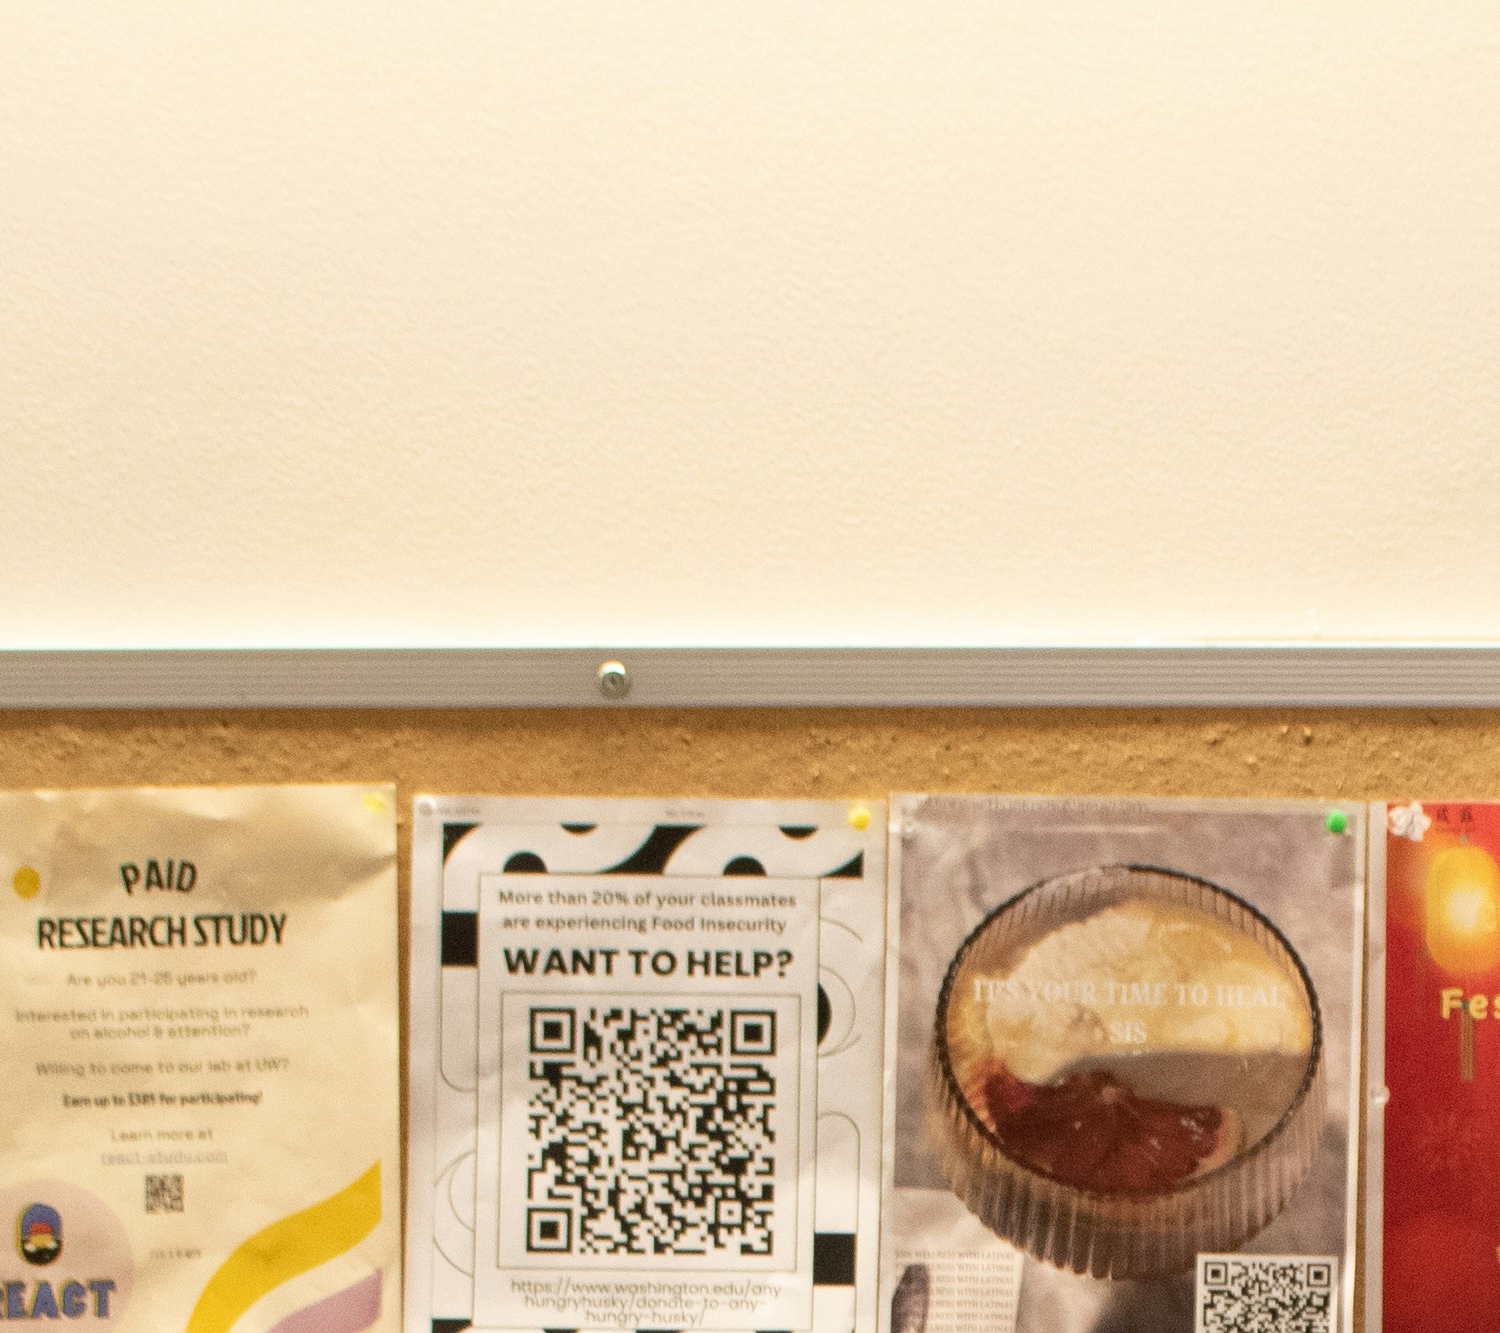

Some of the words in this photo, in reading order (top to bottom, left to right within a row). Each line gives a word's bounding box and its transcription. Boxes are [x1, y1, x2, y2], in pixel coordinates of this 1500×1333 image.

[120, 861, 198, 897] PAID
[498, 888, 539, 907] More
[545, 890, 585, 907] than
[591, 890, 629, 907] 20%
[635, 889, 650, 906] of
[654, 893, 690, 912] your
[696, 891, 796, 908] classmates
[37, 917, 188, 950] RESEARCH
[192, 914, 288, 947] STUDY
[503, 948, 618, 977] WANT
[626, 948, 678, 977] TO
[686, 948, 792, 977] HELP?
